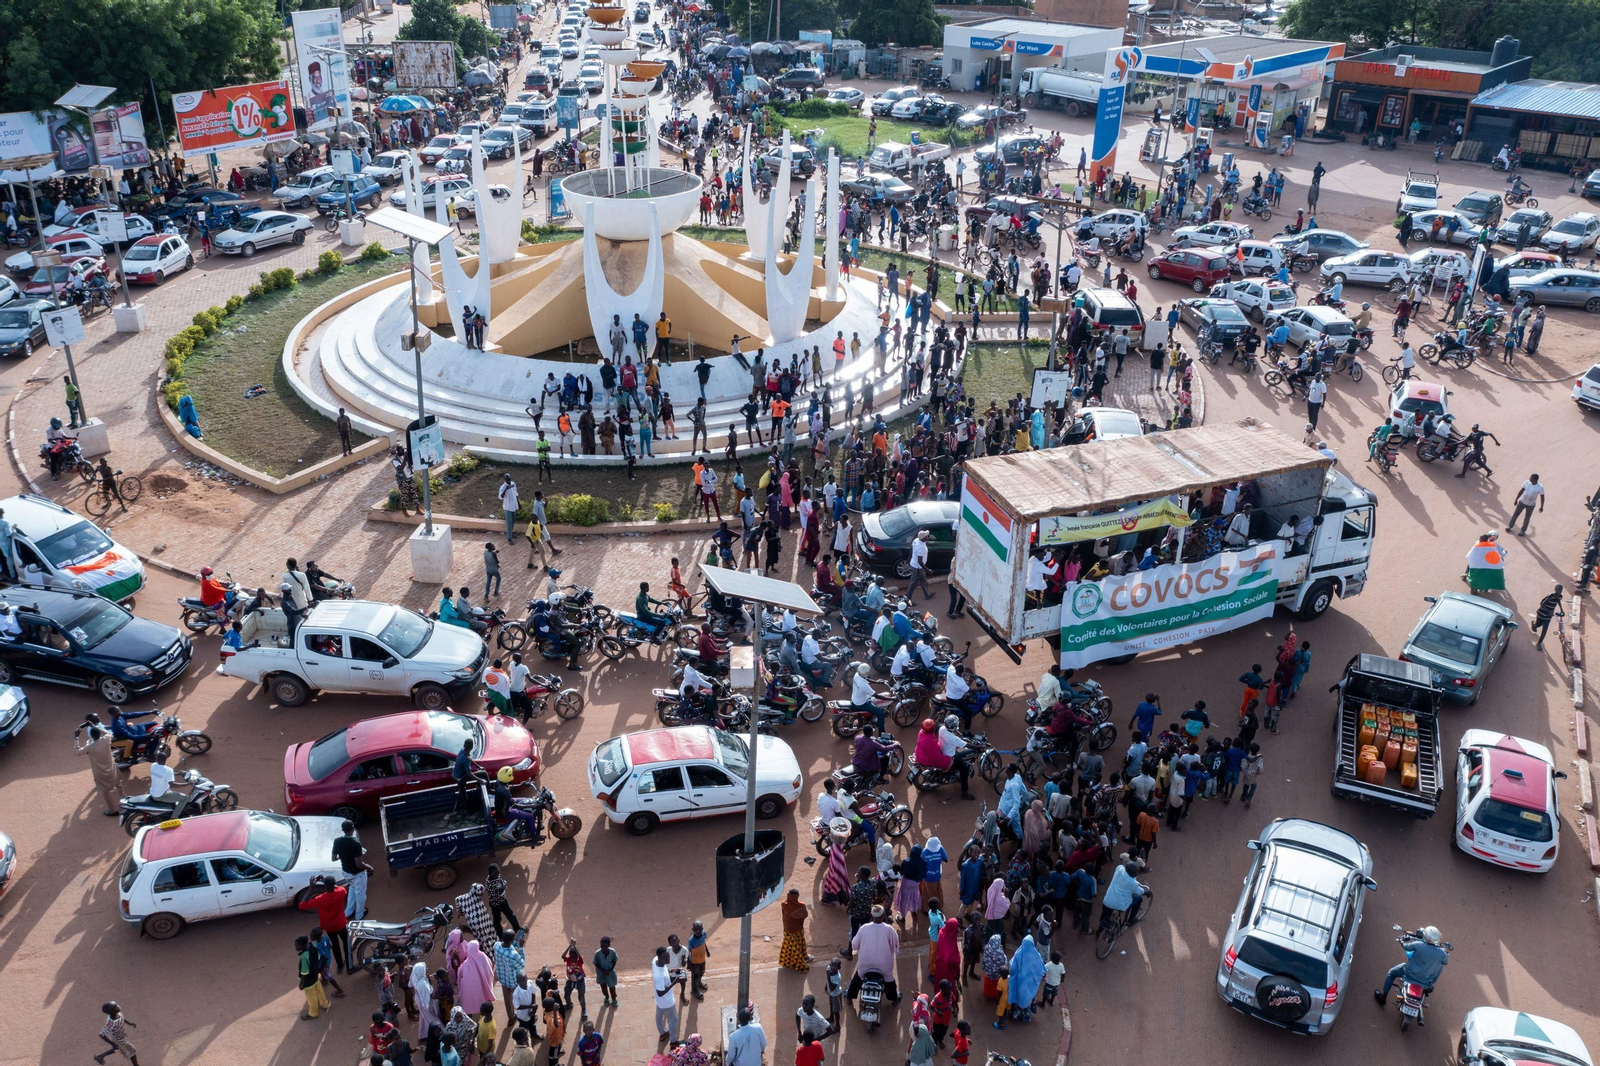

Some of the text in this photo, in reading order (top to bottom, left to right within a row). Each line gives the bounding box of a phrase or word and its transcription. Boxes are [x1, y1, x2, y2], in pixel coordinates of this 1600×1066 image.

[1364, 62, 1389, 74] FOOD
[195, 112, 231, 122] l'application
[234, 102, 260, 130] 1%
[4, 129, 24, 138] pour
[210, 127, 225, 135] partir
[1100, 519, 1121, 527] QUITTEZ
[1110, 566, 1230, 611] COVOCS
[1068, 590, 1268, 644] Comité des Volontaires pour la Cohésion Sociale
[1124, 640, 1146, 650] UNITÉ
[1154, 630, 1190, 645] COHÉSION
[1199, 626, 1216, 635] PAIX
[1213, 760, 1221, 770] 19
[264, 886, 274, 895] 798
